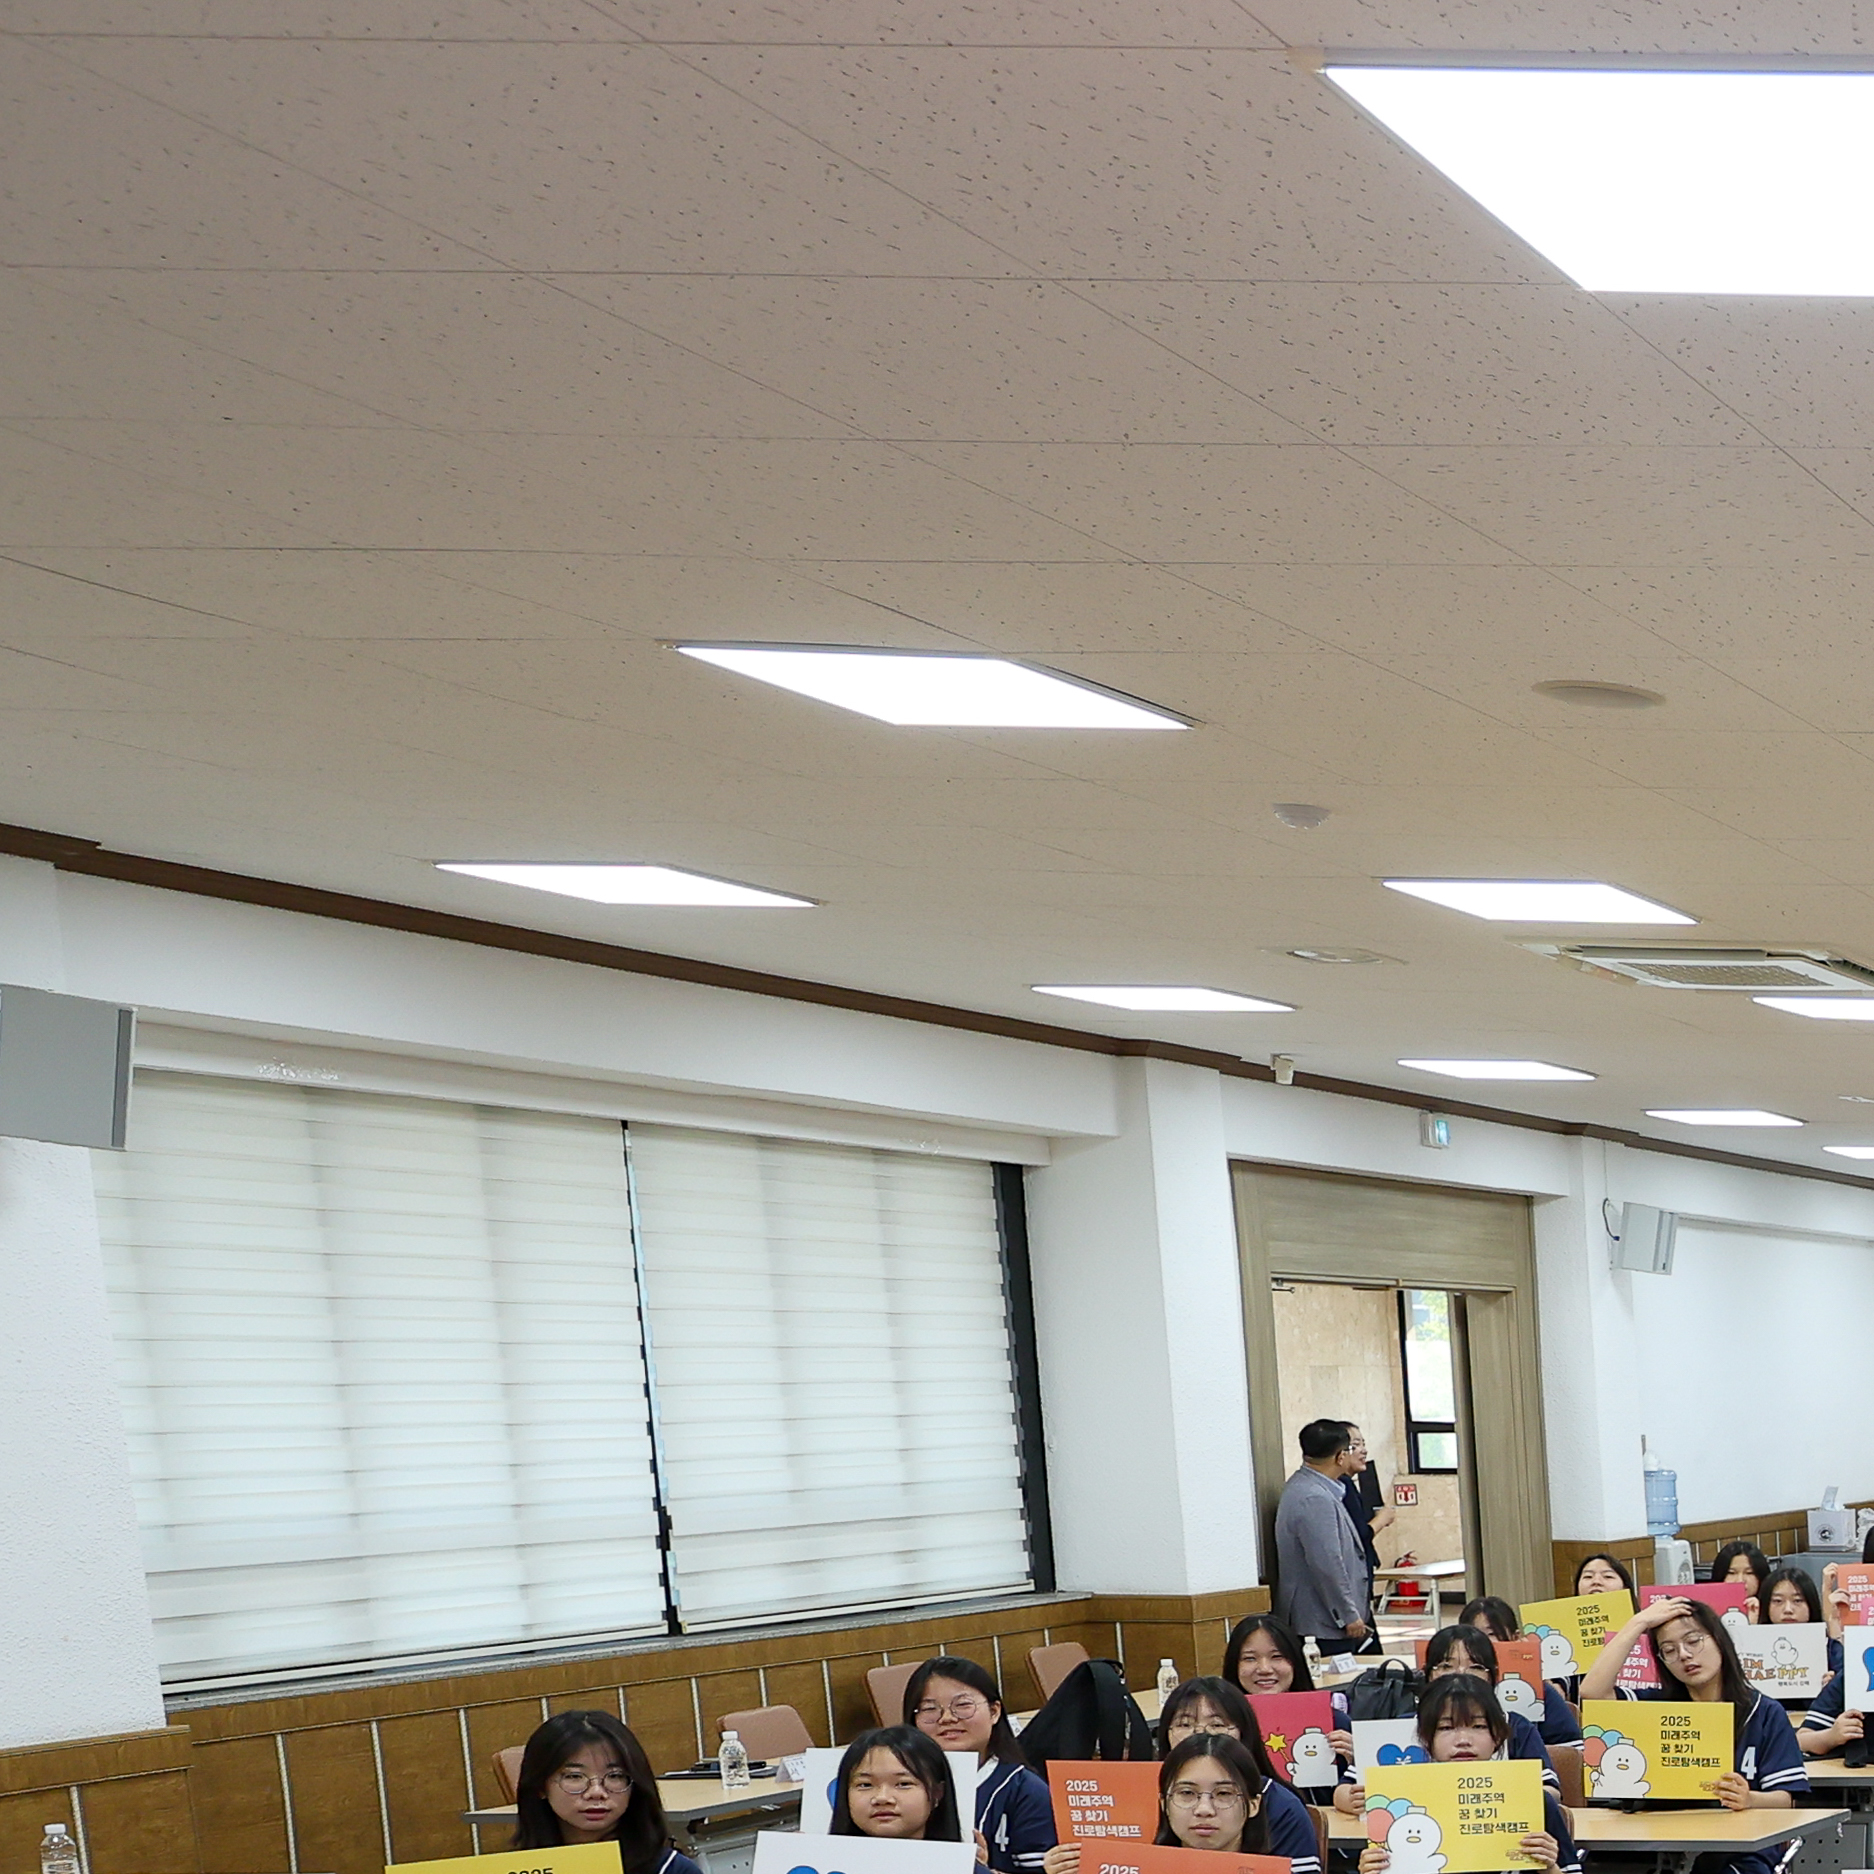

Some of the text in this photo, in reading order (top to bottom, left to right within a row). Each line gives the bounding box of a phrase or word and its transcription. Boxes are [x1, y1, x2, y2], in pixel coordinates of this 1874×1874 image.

[1661, 1716, 1690, 1726] 2025
[1661, 1730, 1700, 1740] 미래주역
[1661, 1744, 1693, 1753] 꿈 찾기
[1662, 1757, 1720, 1767] 진로탐색캠프
